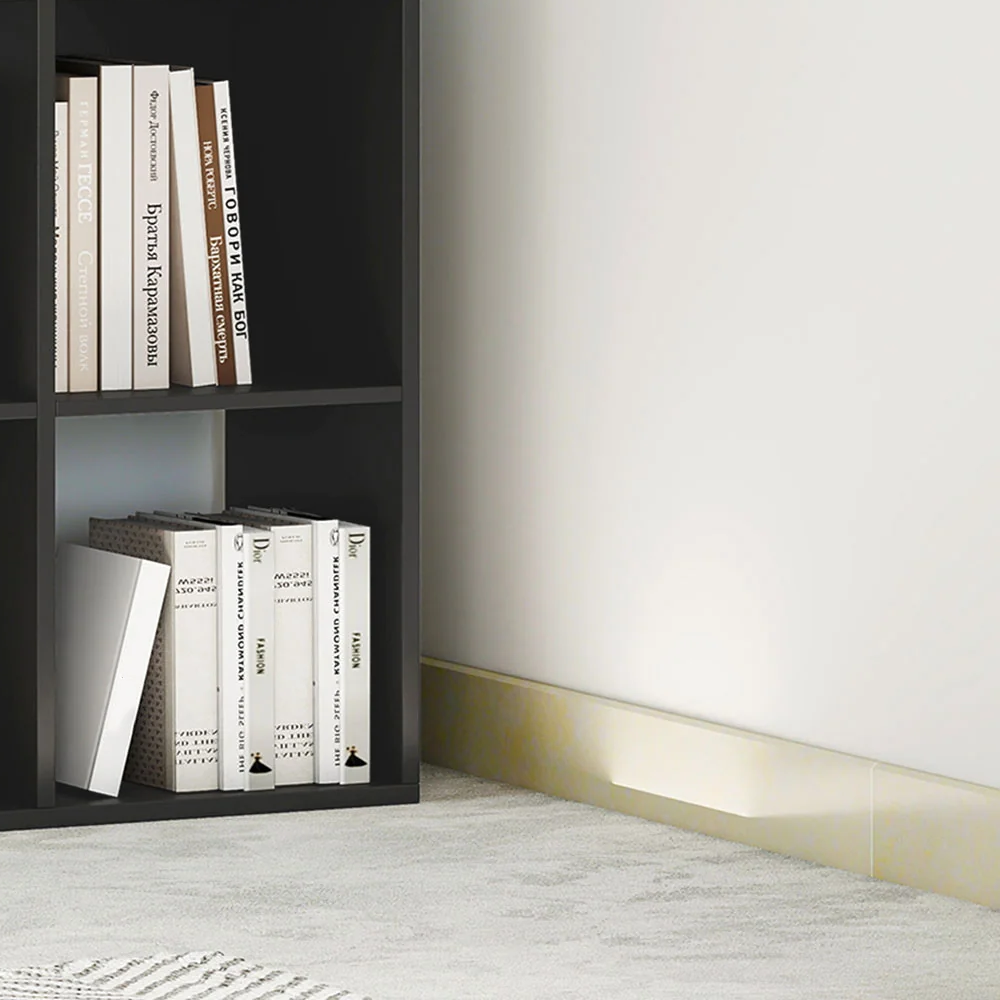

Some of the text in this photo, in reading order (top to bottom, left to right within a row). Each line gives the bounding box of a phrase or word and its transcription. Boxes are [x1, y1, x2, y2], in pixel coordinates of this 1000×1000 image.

[80, 102, 89, 159] ГЕРМАН
[77, 163, 93, 224] ГЕССЕ
[142, 203, 162, 261] Братья
[224, 186, 241, 265] ГОВОРИ
[77, 250, 93, 329] Степной
[208, 235, 223, 312] Бархатная
[231, 272, 244, 304] КАК
[142, 265, 162, 367] Карамазовы
[214, 314, 228, 364] смерть
[234, 310, 248, 340] БОГ
[253, 538, 270, 563] Dior
[348, 533, 365, 557] Dior
[256, 638, 266, 674] FASHION
[351, 632, 361, 668] FASHION
